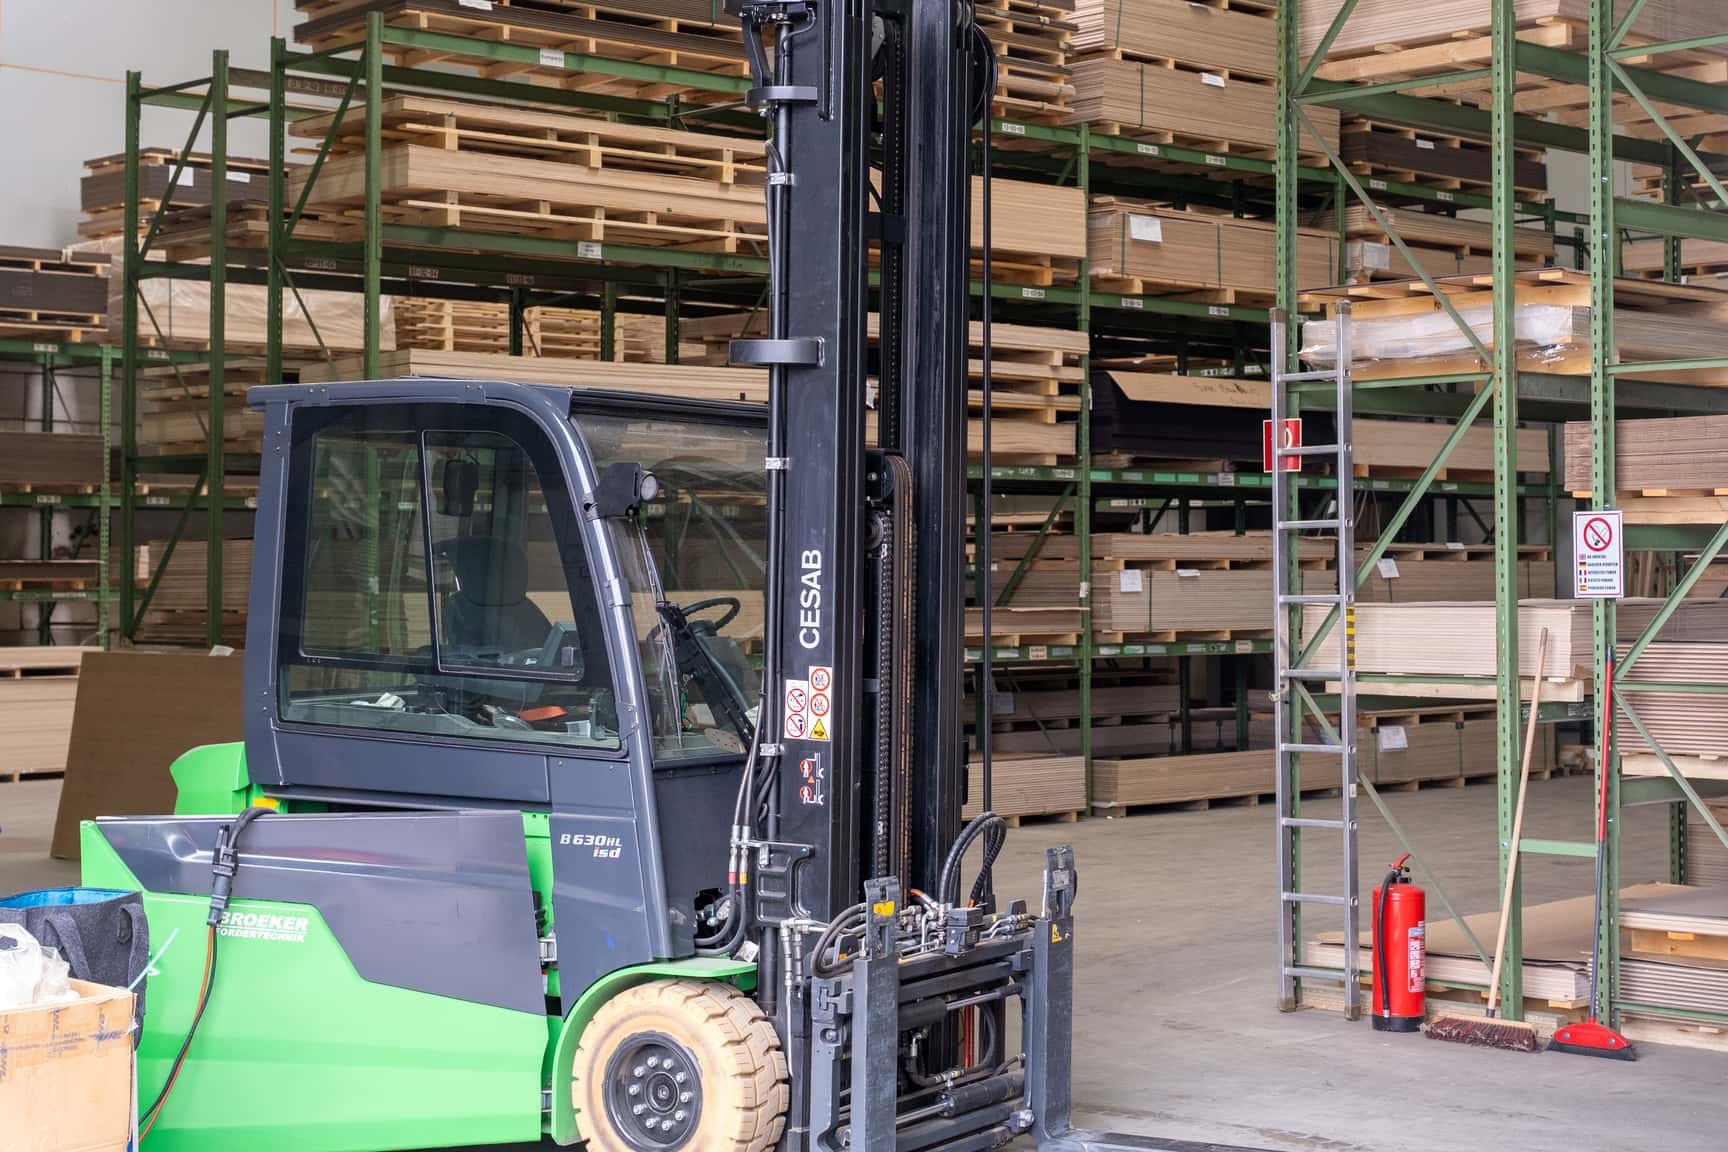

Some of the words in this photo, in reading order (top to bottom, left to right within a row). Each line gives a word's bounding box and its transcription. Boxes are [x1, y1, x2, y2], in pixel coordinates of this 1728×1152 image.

[799, 549, 822, 649] CESAB
[560, 833, 571, 845] B
[221, 911, 309, 931] BROEKER
